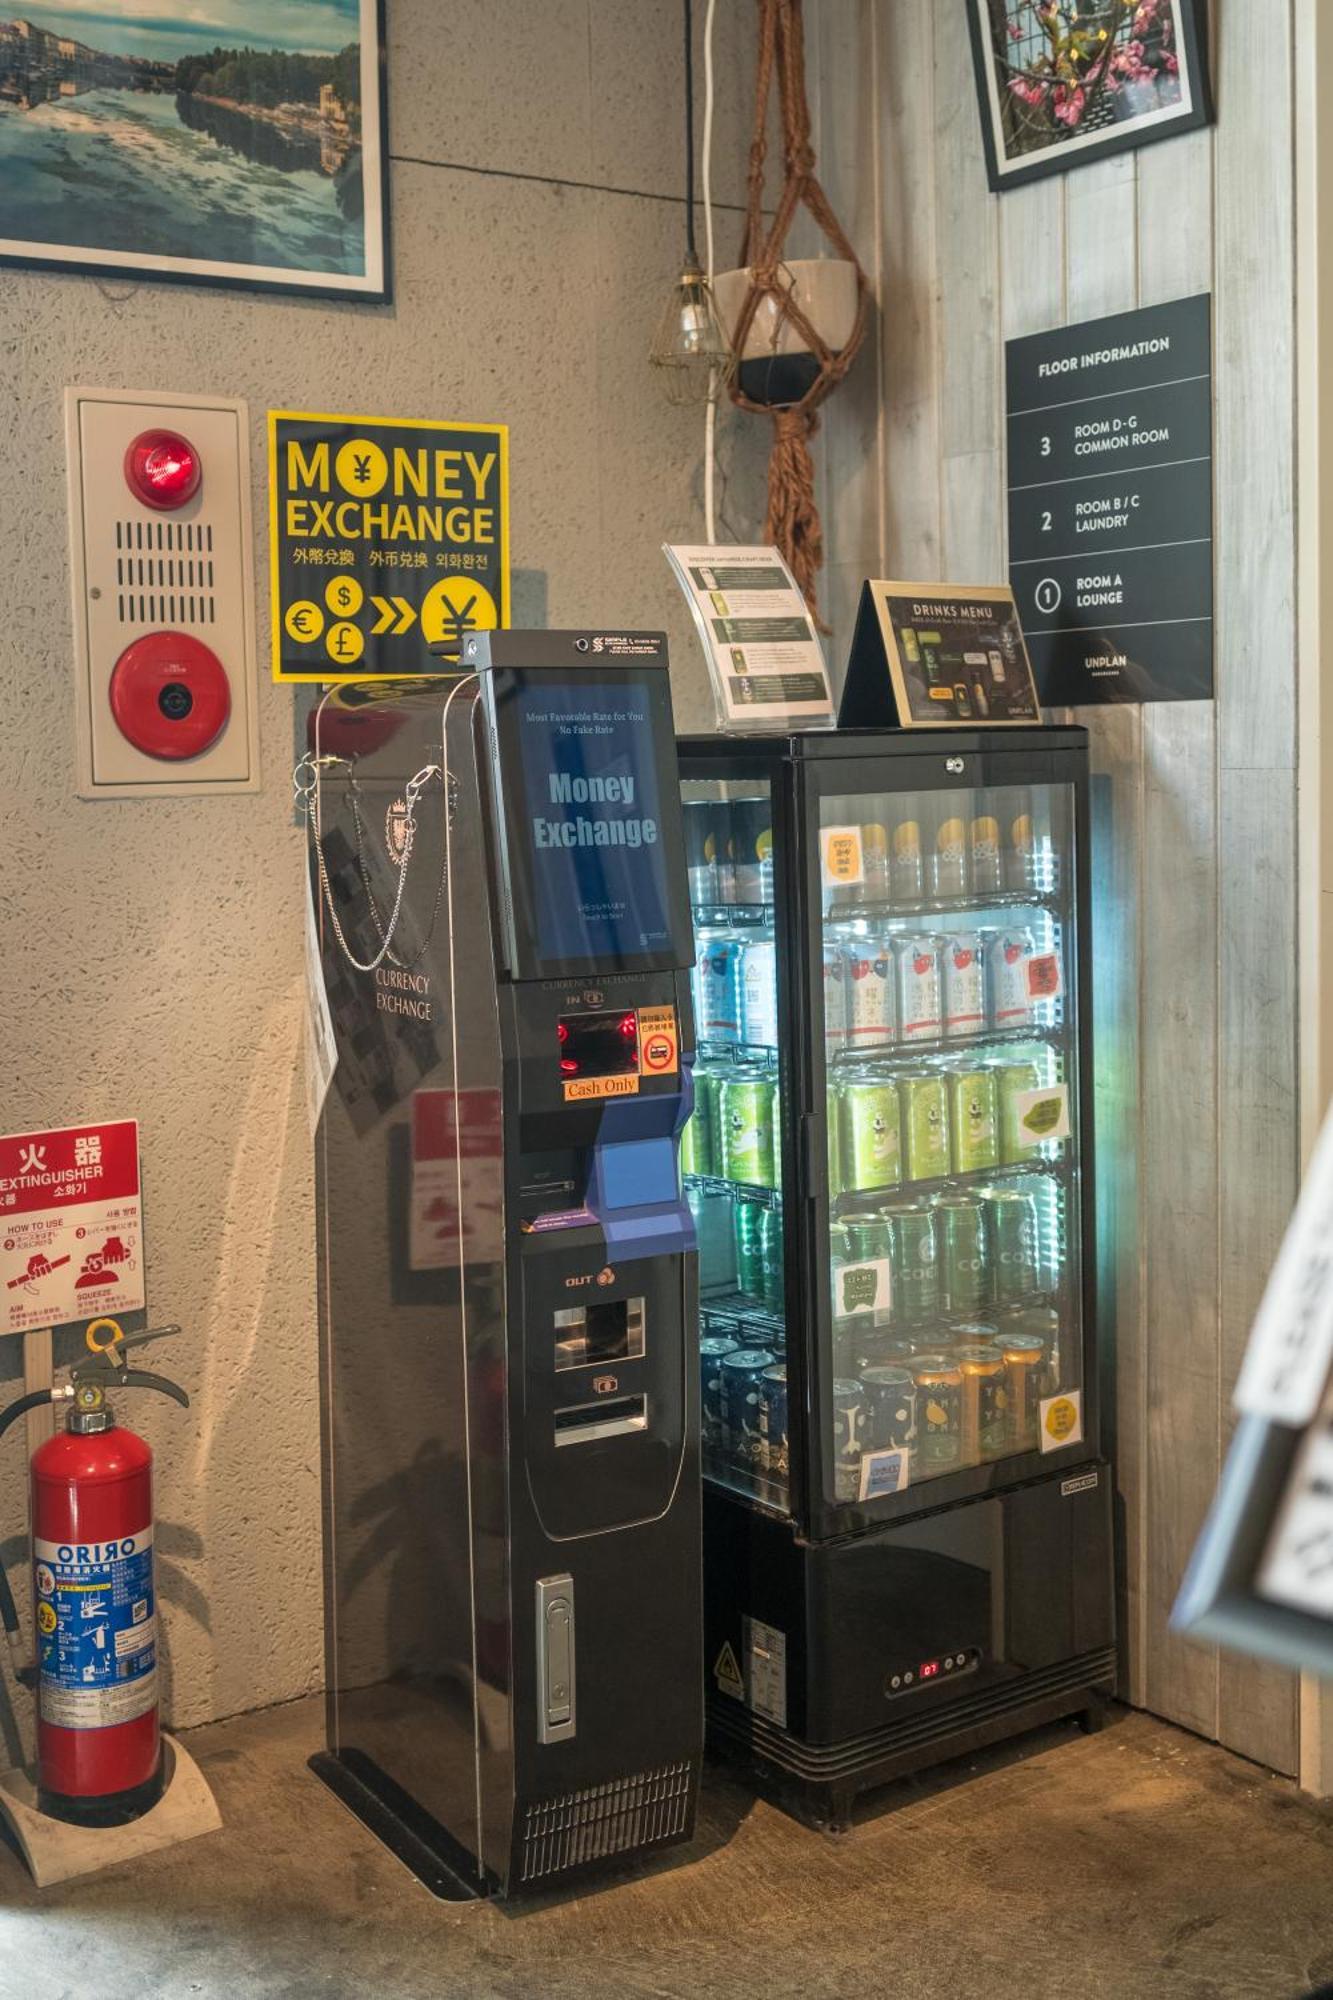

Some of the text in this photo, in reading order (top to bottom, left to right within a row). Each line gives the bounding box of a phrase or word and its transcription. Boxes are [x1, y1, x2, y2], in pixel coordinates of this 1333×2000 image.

[1038, 336, 1170, 378] FLOOR INFORMATION
[1075, 420, 1110, 438] ROOM
[1041, 437, 1051, 456] 3
[1074, 428, 1169, 455] COMMON ROOM
[1076, 498, 1110, 515] ROOM
[286, 499, 494, 544] EXCHANGE
[1041, 511, 1052, 531] 2
[1076, 514, 1129, 532] LAUNDRY
[1076, 574, 1123, 590] ROOM A
[1076, 591, 1123, 607] LOUNGE
[913, 604, 993, 618] DRINKS MENU
[1085, 655, 1127, 669] UNPLAN
[526, 712, 548, 721] Most
[593, 711, 612, 721] Rate
[614, 711, 626, 721] for
[628, 711, 644, 721] You
[560, 725, 614, 734] No Fake Rate
[549, 772, 635, 804] Money
[533, 815, 657, 849] Exchange
[376, 968, 431, 995] CURRENCY
[376, 993, 432, 1021] EXCHANGE
[568, 1077, 635, 1097] Cash Only
[0, 1165, 103, 1191] EXTINGUISHER
[53, 1181, 86, 1197] 소화기
[7, 1218, 64, 1235] HOW TO USE
[566, 1274, 594, 1288] OUT
[9, 1304, 24, 1313] AIM
